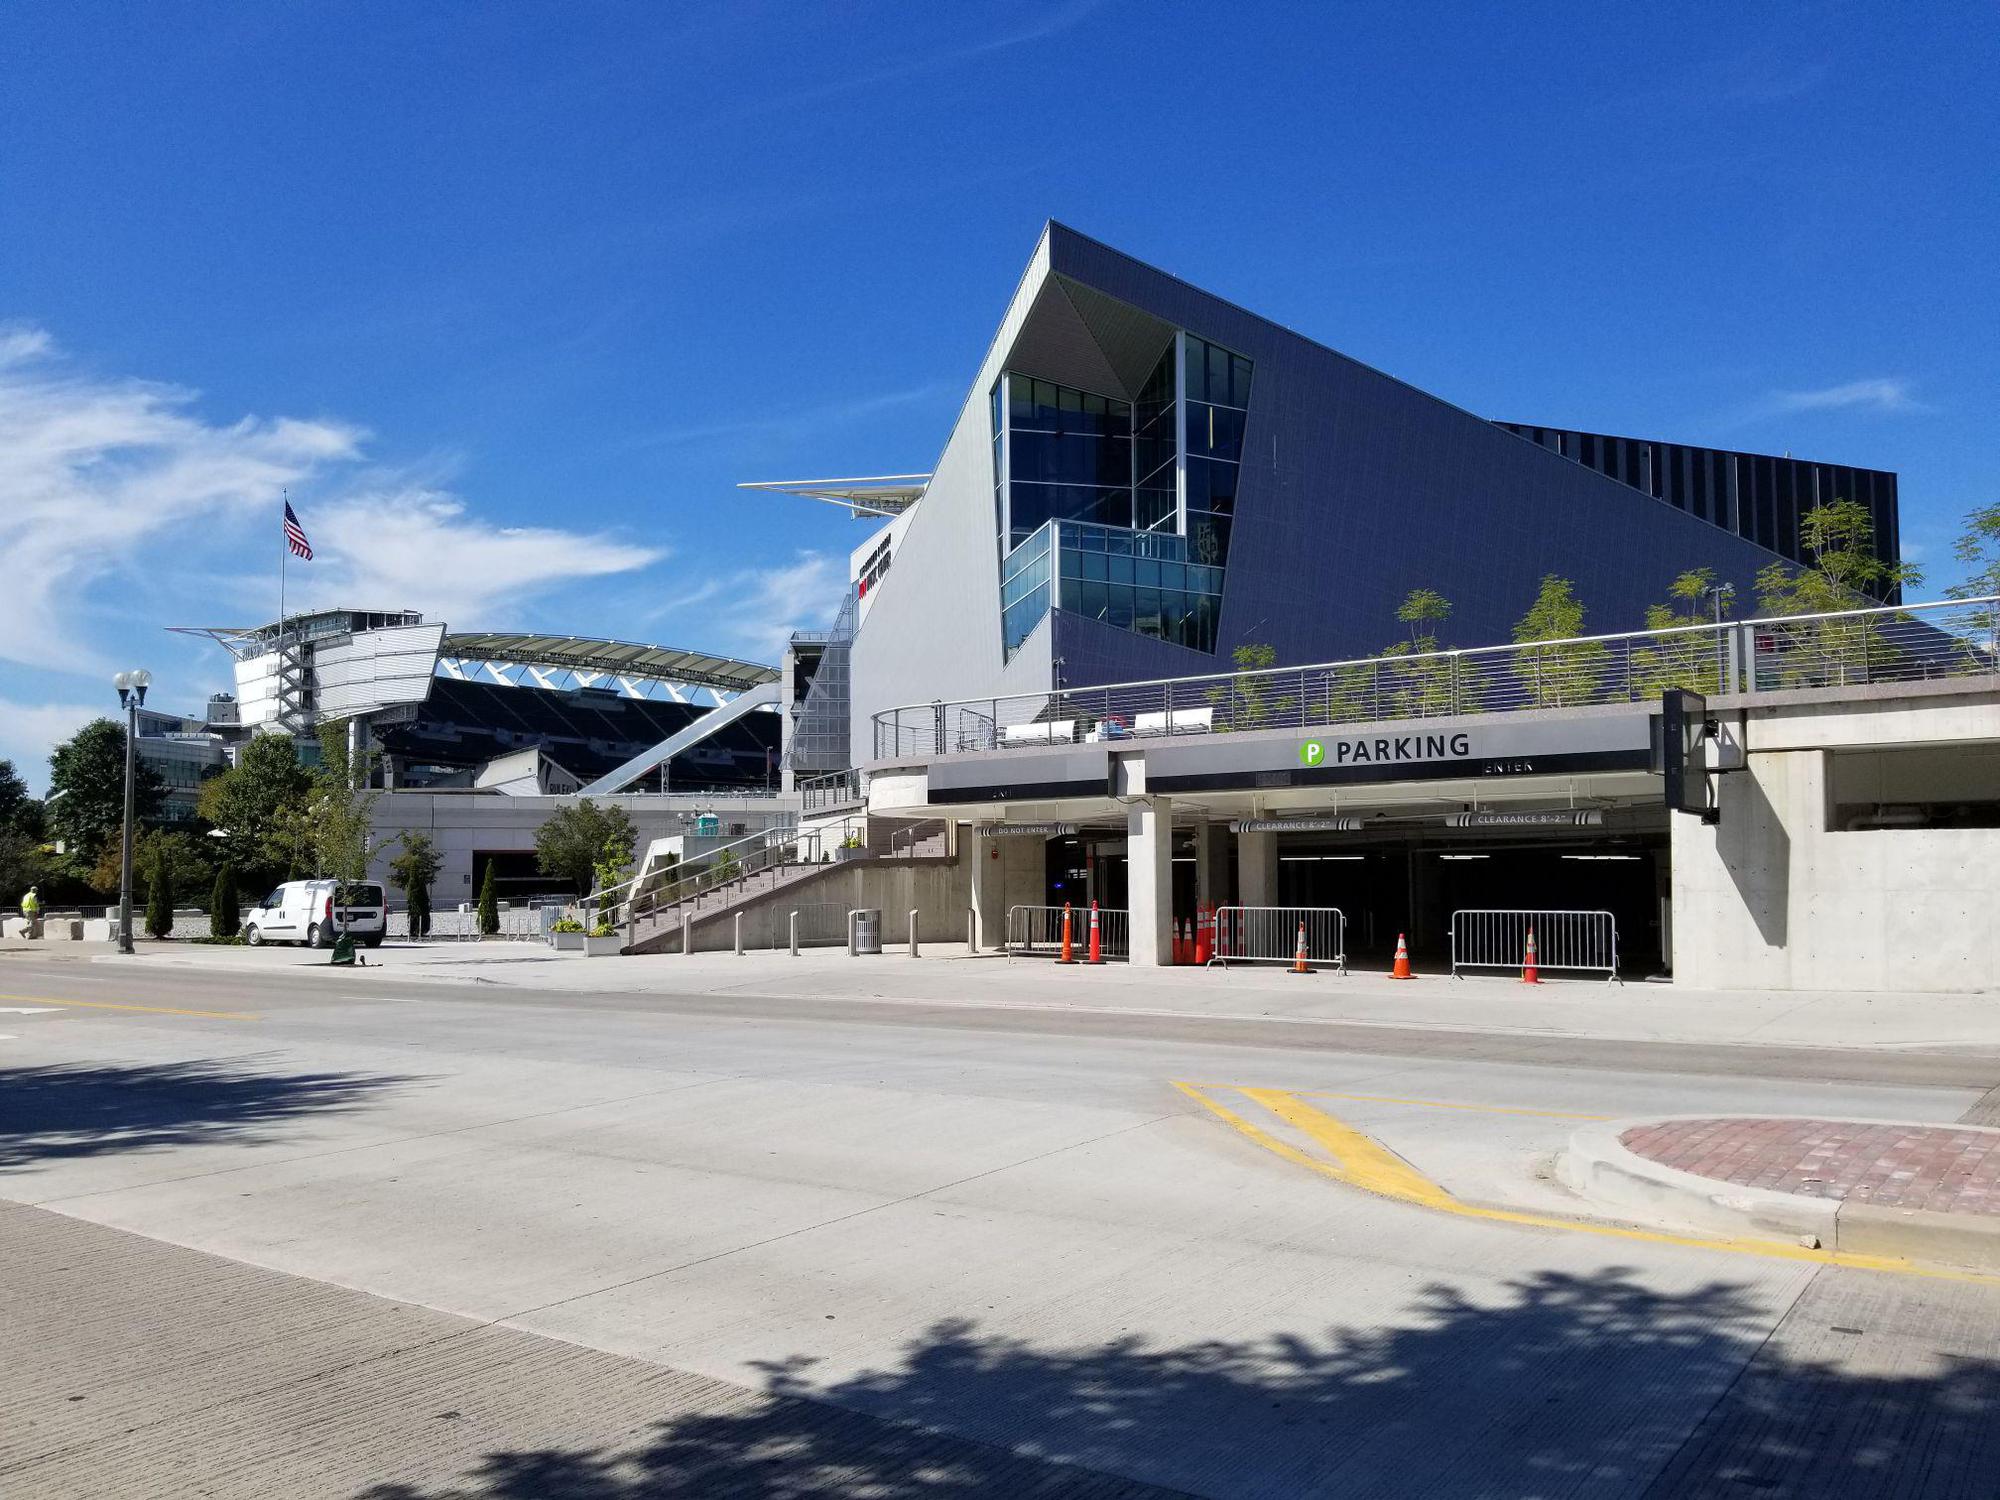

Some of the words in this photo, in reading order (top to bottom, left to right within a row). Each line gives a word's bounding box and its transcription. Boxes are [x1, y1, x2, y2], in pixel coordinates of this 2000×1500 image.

[1307, 743, 1320, 763] P
[1337, 733, 1470, 763] PARKING
[1477, 815, 1537, 824] CLEARANCE
[1256, 821, 1306, 830] CLEARANCE
